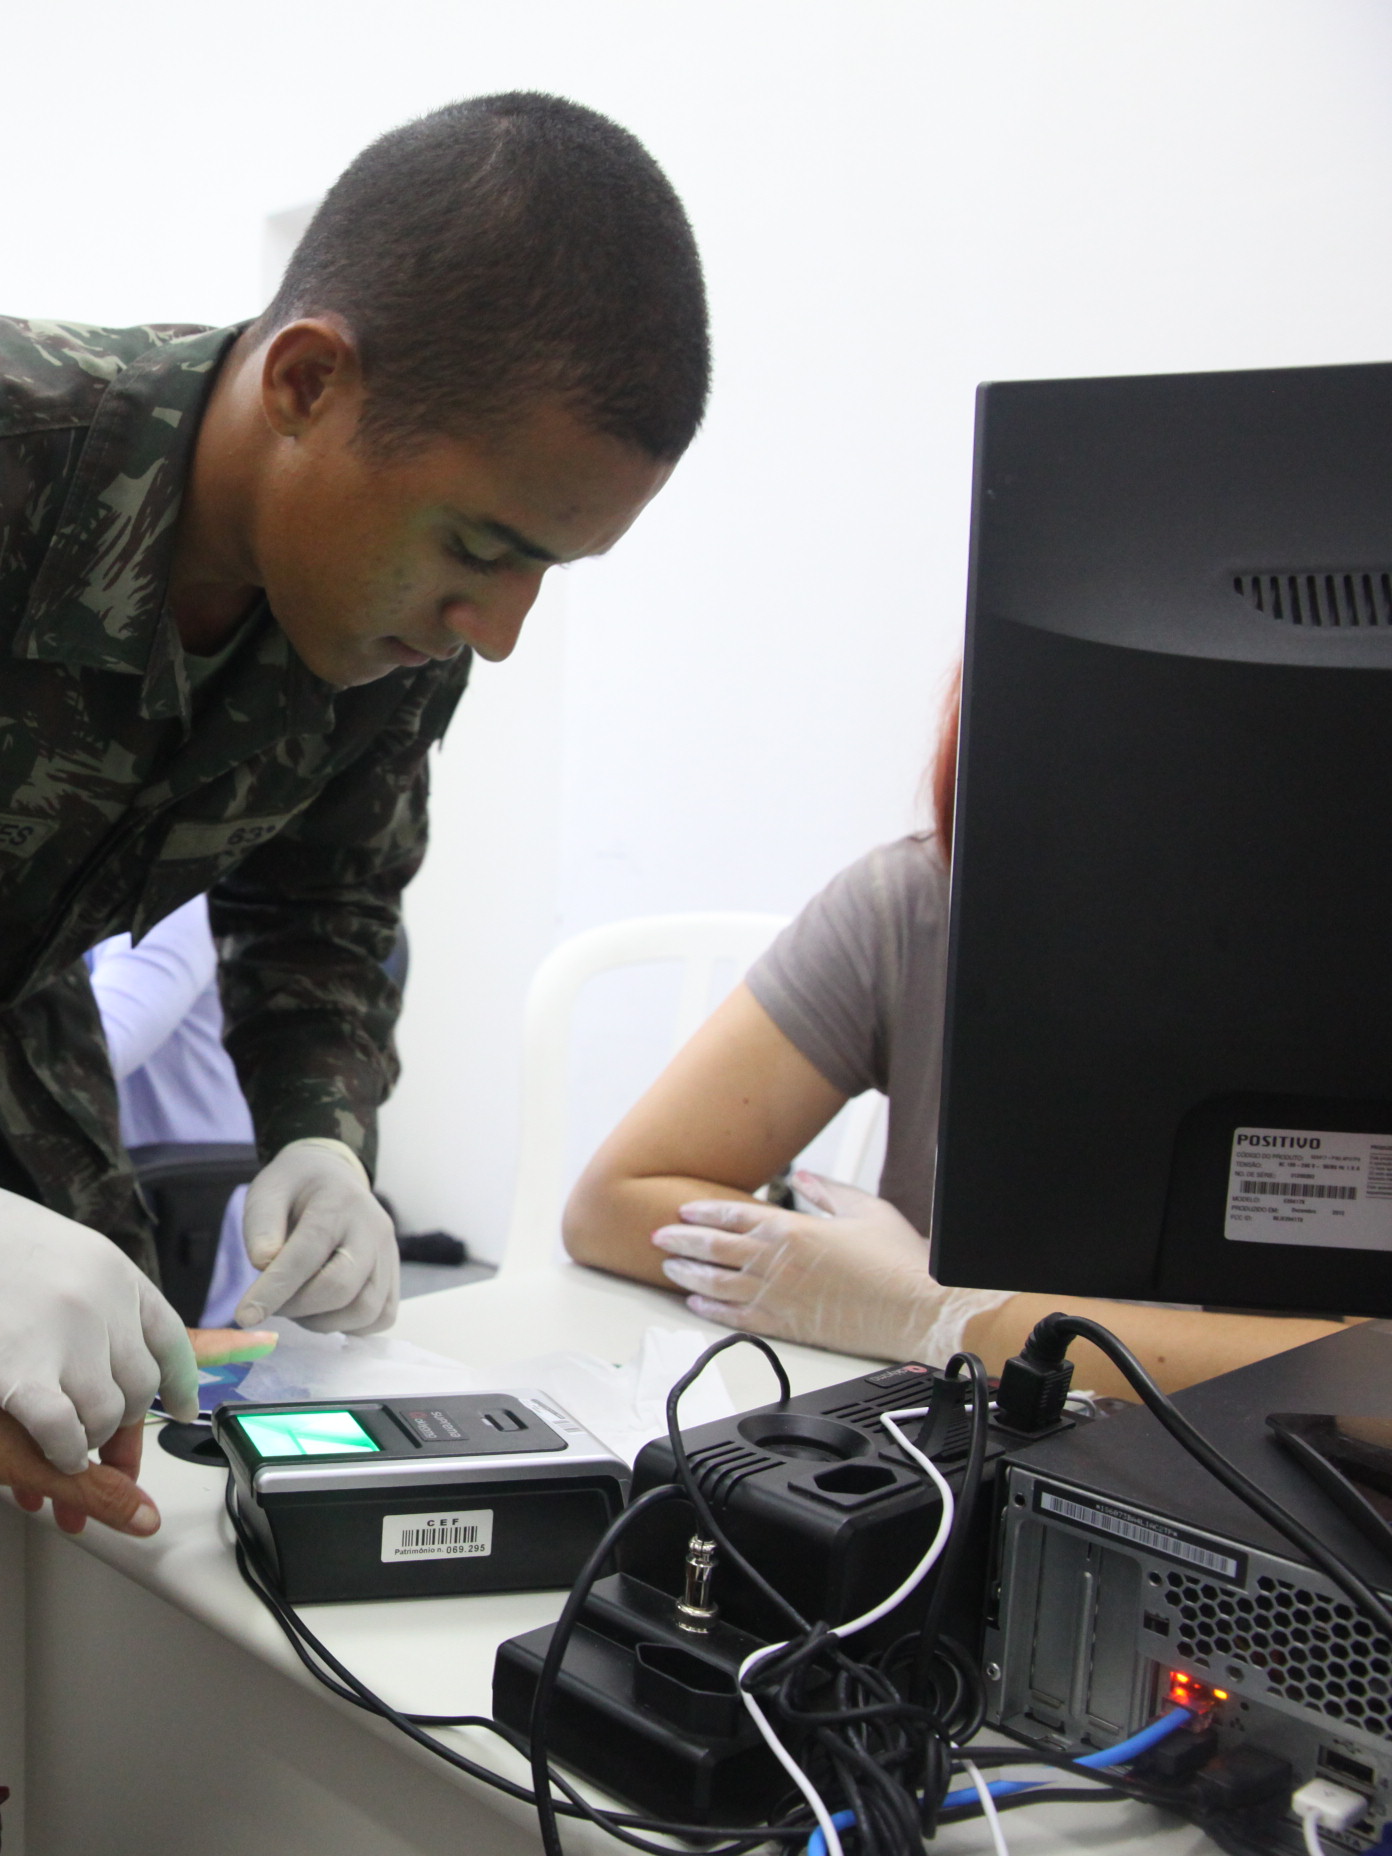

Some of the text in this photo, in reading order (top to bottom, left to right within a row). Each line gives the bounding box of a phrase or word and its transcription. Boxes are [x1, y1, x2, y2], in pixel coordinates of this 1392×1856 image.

[1237, 1134, 1321, 1150] POSITIVO
[431, 1411, 461, 1438] suprema
[394, 1547, 435, 1556] Patrimônio
[446, 1544, 486, 1554] 069.295
